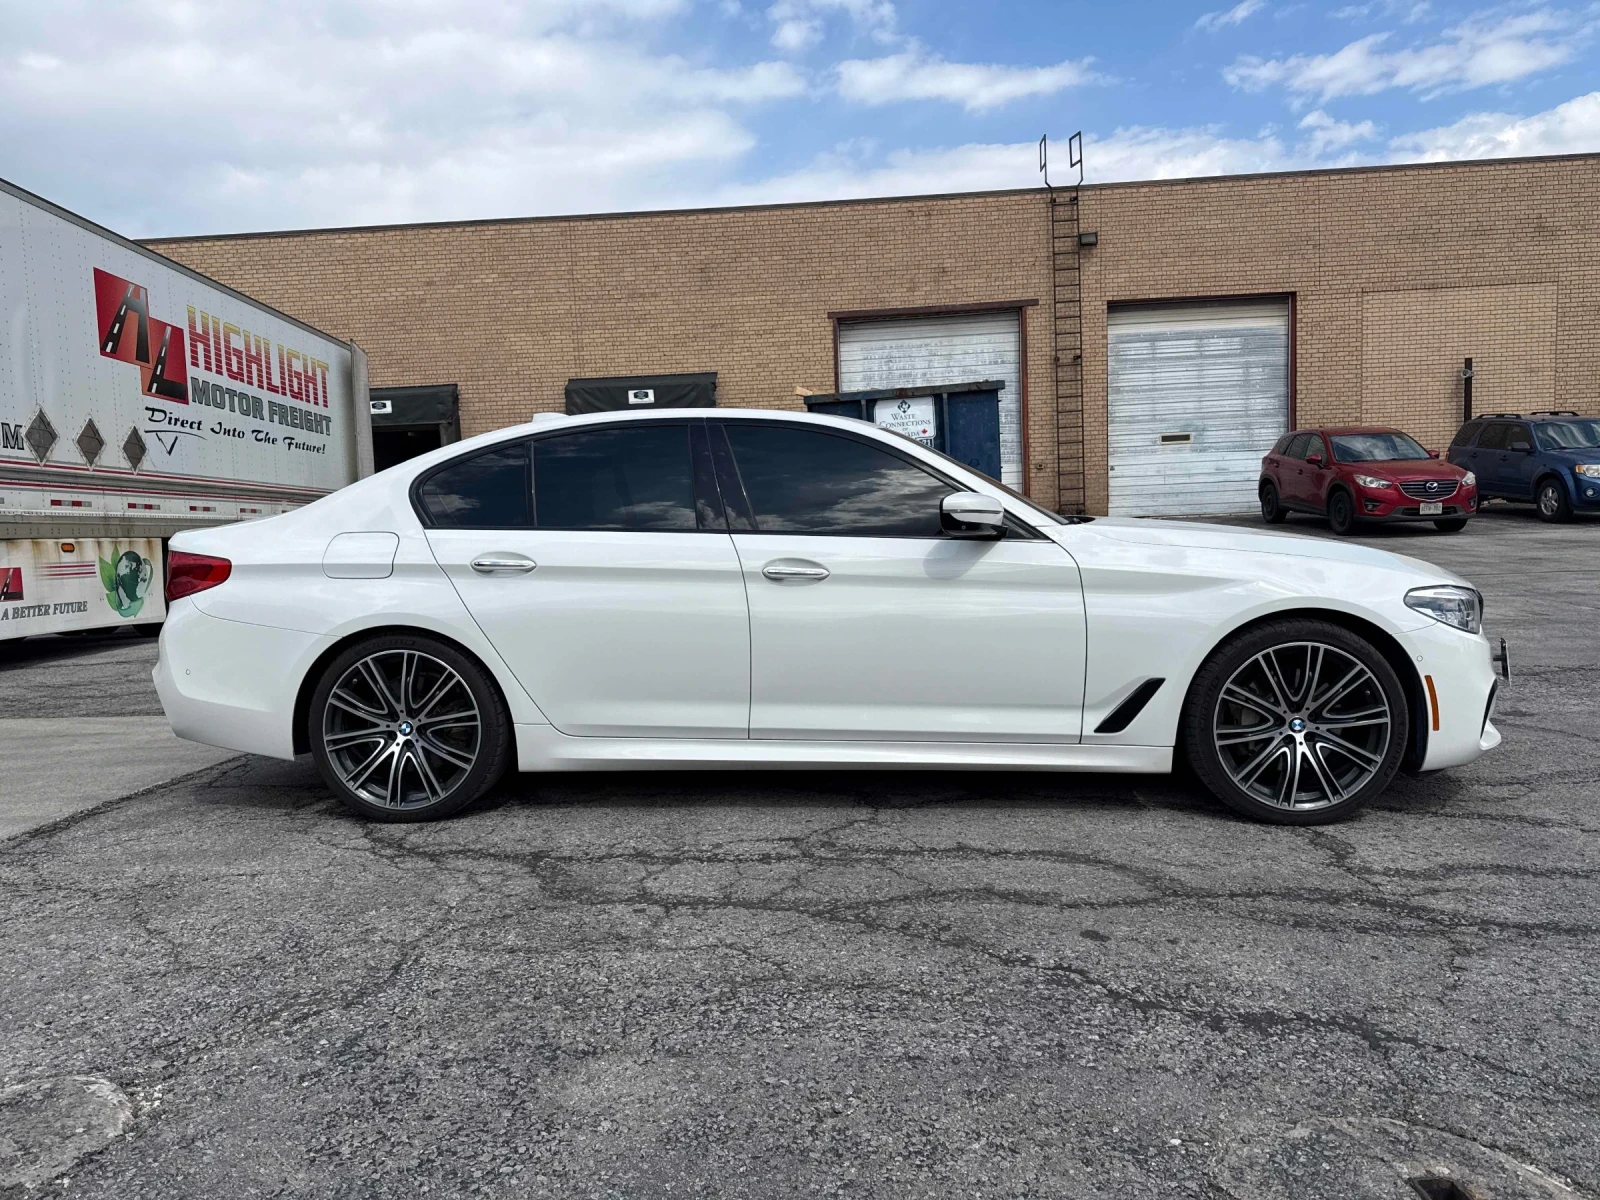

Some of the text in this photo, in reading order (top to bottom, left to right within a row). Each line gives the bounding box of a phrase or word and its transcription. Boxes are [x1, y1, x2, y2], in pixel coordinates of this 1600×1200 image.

[186, 305, 329, 408] HIGHLIGHT
[145, 406, 326, 454] Direct Into The Future!
[190, 377, 331, 436] MOTOR FREIGHT
[1, 601, 88, 620] A BETTER FUTURE
